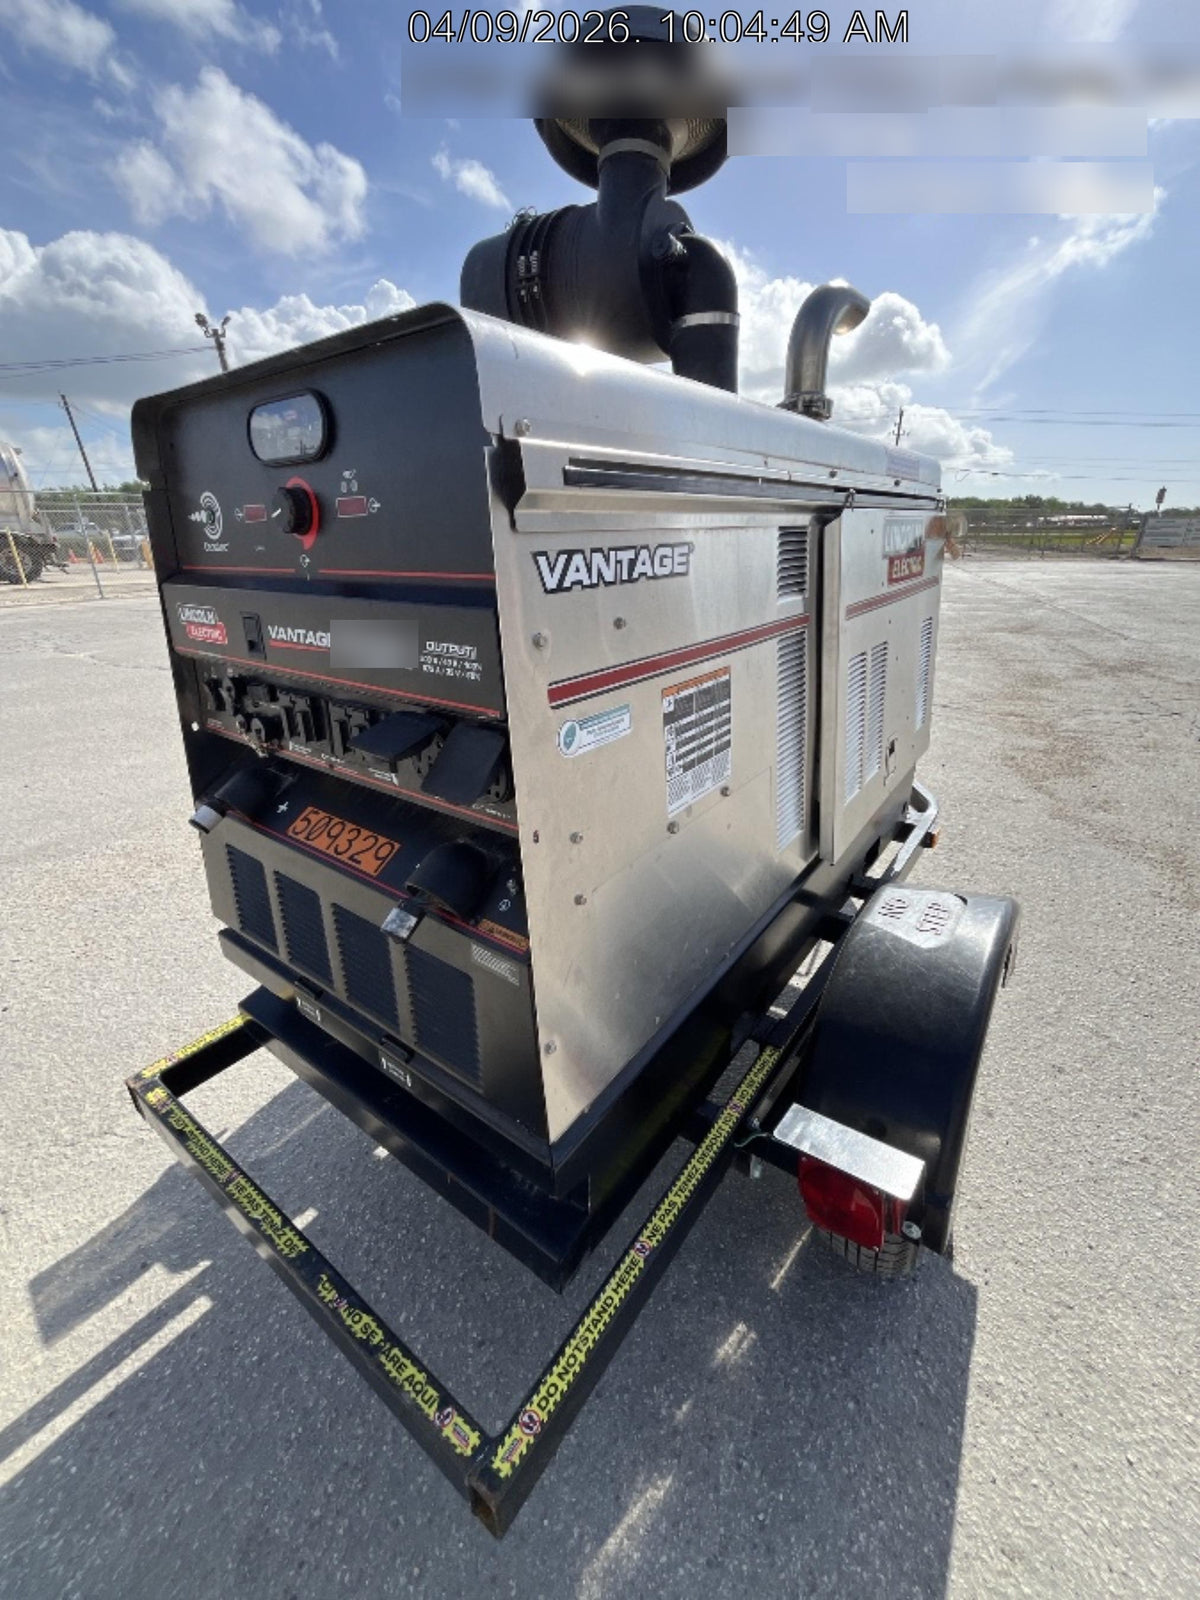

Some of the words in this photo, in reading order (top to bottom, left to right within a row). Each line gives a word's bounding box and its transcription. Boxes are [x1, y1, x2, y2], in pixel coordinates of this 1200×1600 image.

[531, 542, 692, 594] VANTAGE
[268, 625, 331, 648] VANTAG
[426, 641, 473, 660] OUTPUT
[292, 808, 395, 874] 509329
[242, 1191, 262, 1211] PAS
[645, 1222, 662, 1242] NE
[657, 1199, 678, 1224] PAS
[672, 1164, 701, 1200] TENEZ
[696, 1126, 726, 1165] DEBOUT
[341, 1302, 364, 1326] NO
[358, 1321, 379, 1342] SE
[534, 1381, 560, 1411] DO
[554, 1341, 587, 1382] NOT
[577, 1294, 617, 1345] STAND
[609, 1255, 641, 1295] HERE
